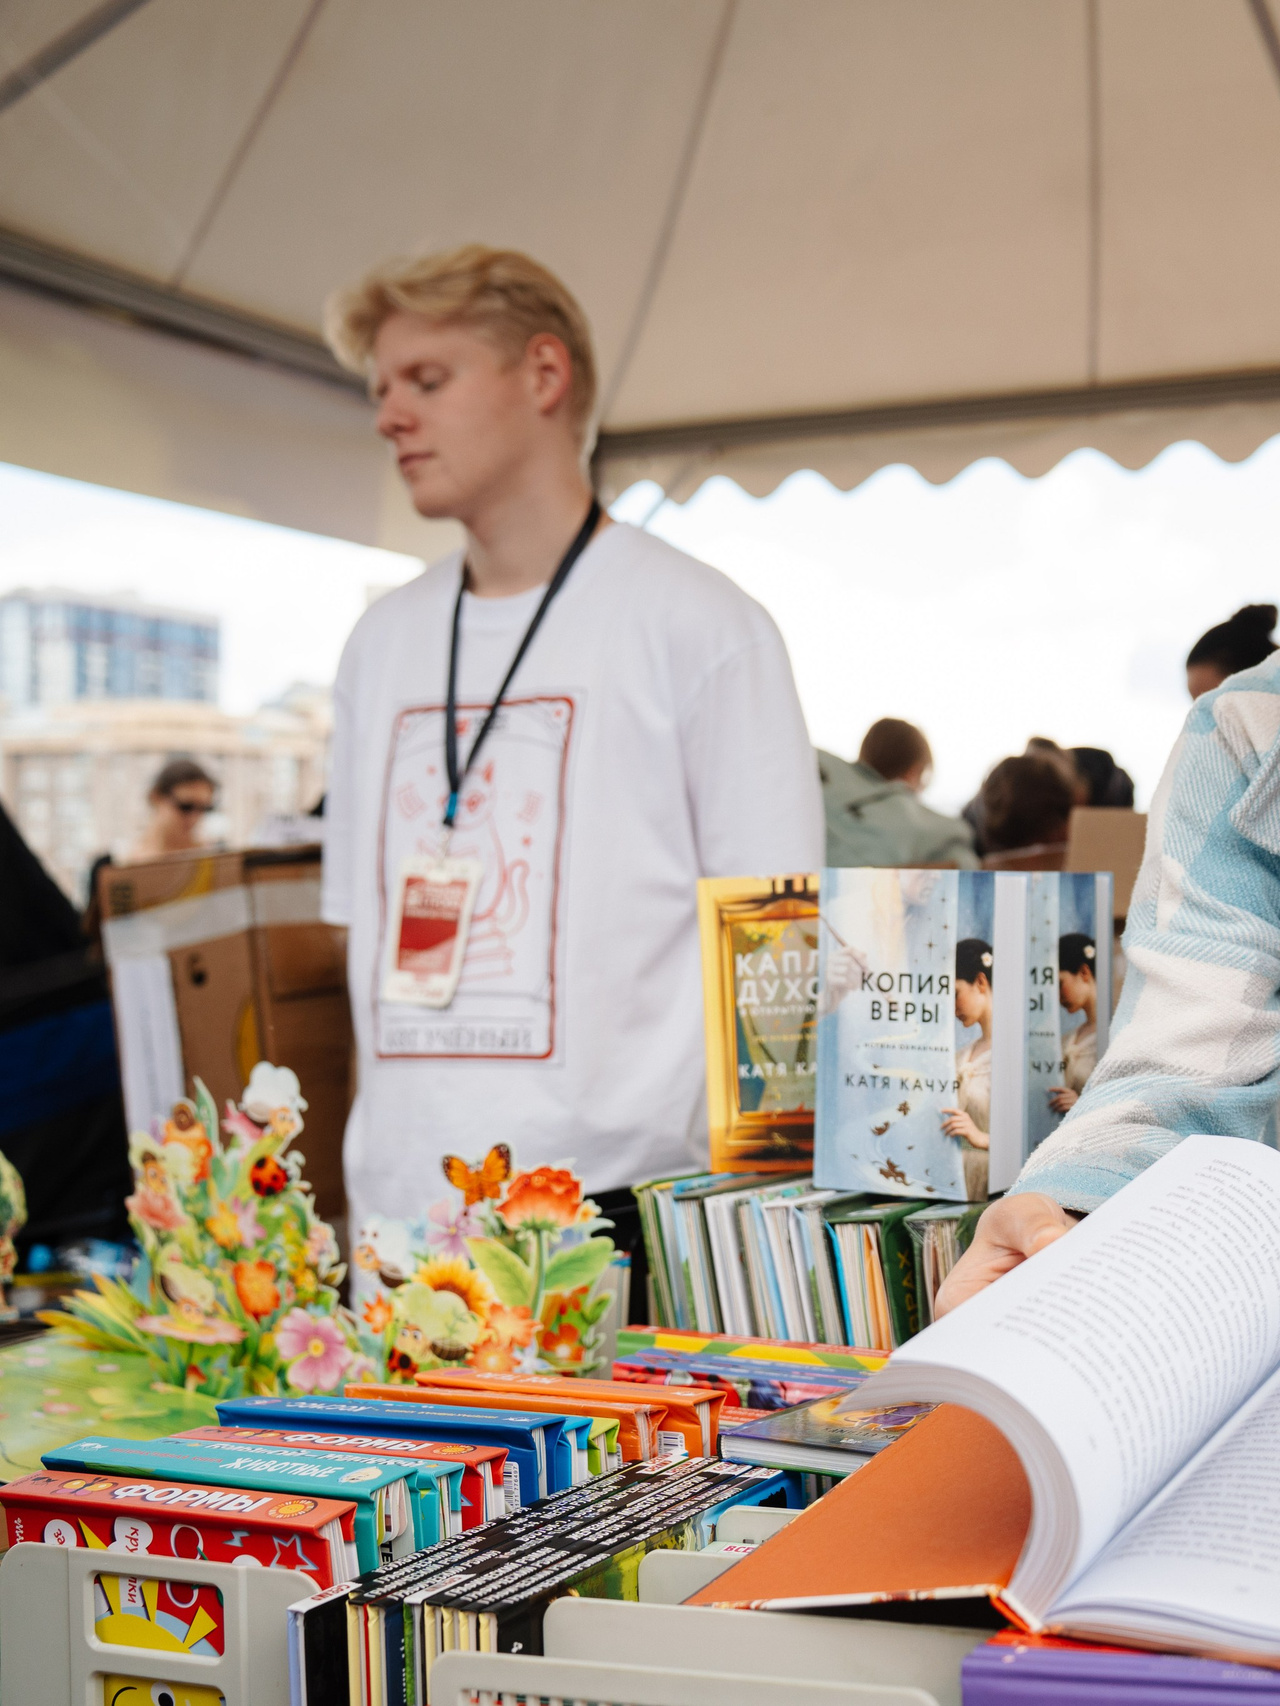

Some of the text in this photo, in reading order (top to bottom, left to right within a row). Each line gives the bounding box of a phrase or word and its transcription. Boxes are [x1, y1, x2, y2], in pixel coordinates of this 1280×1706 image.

[860, 971, 950, 996] КОПИЯ
[871, 1000, 940, 1024] ВЕРЫ
[845, 1072, 961, 1095] КАТЯ КАЧУР
[282, 1431, 434, 1452] ФОРМЫ
[219, 1457, 345, 1479] ЖИВОТНЫЕ
[113, 1483, 275, 1514] ФОРМЫ
